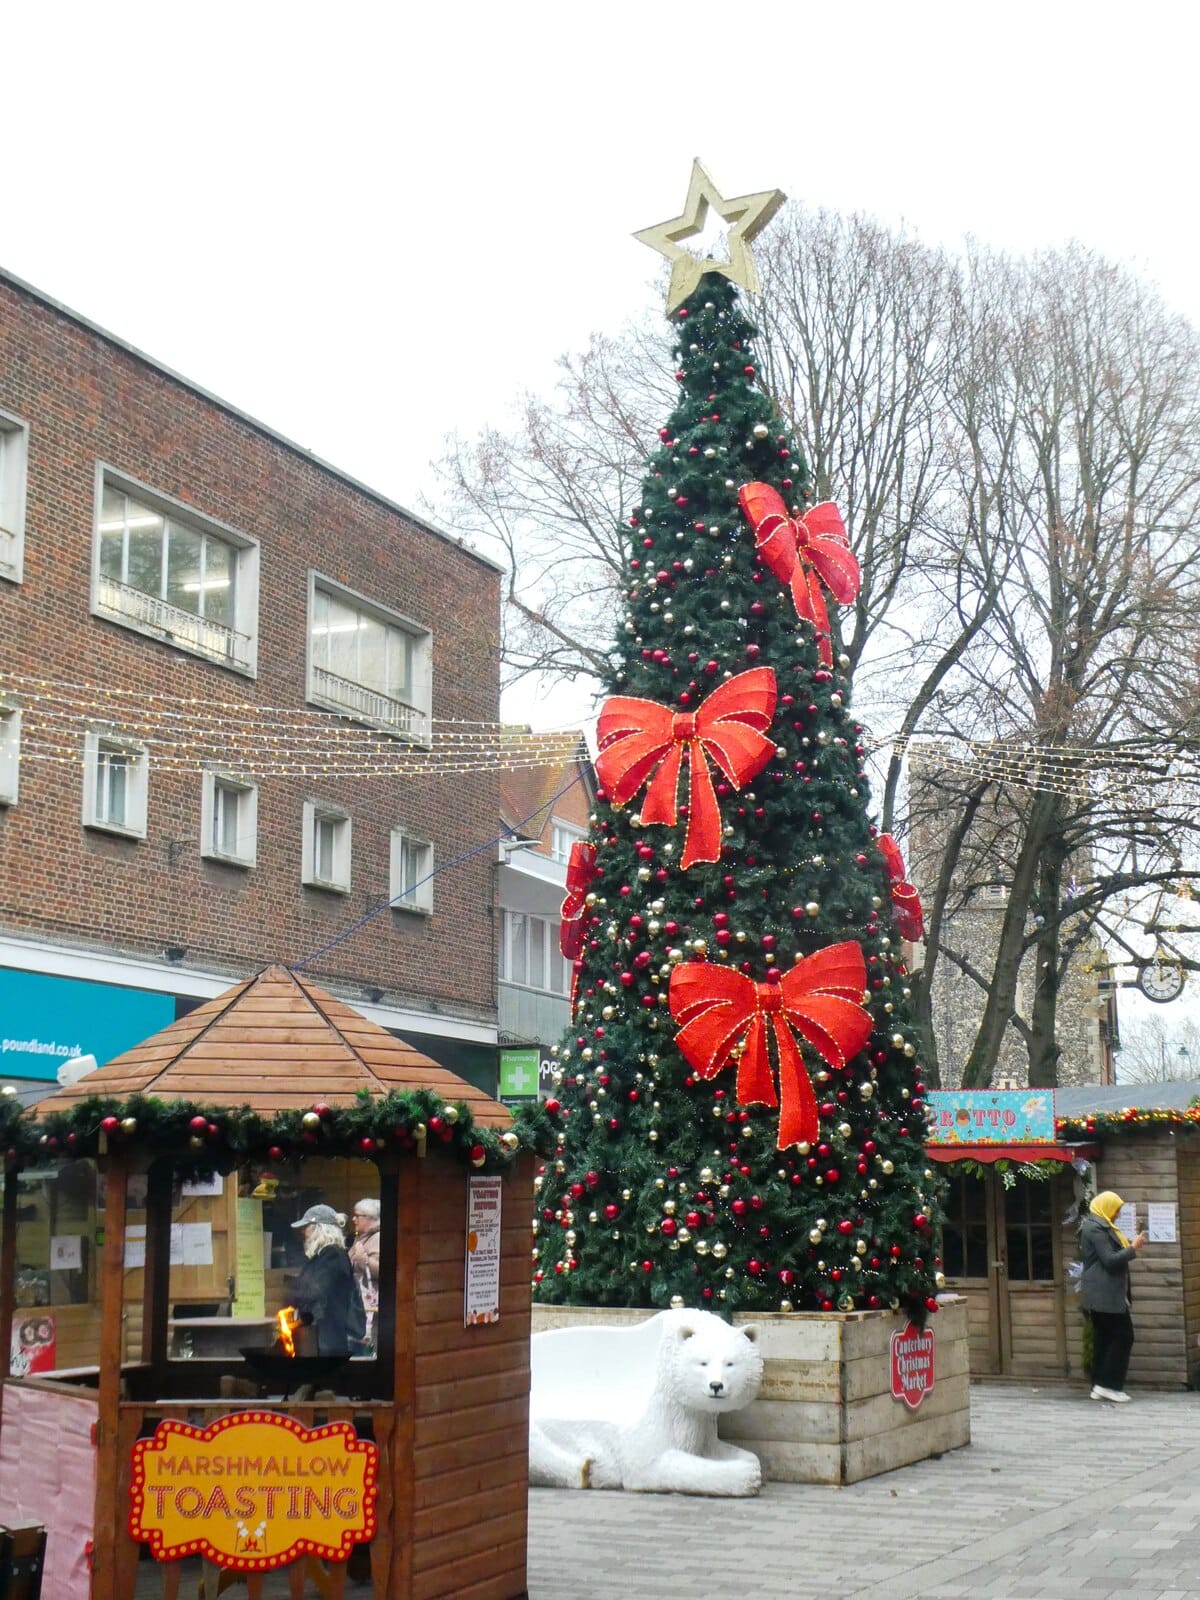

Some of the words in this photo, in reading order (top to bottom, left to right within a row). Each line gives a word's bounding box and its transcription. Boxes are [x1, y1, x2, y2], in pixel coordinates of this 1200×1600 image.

[2, 1038, 82, 1057] poundland.co.uk
[895, 1335, 932, 1356] Canterbury
[897, 1354, 931, 1375] Christmas
[901, 1371, 927, 1391] Market
[157, 1455, 352, 1477] MARSHMALLOW
[147, 1485, 359, 1520] TOASTING
